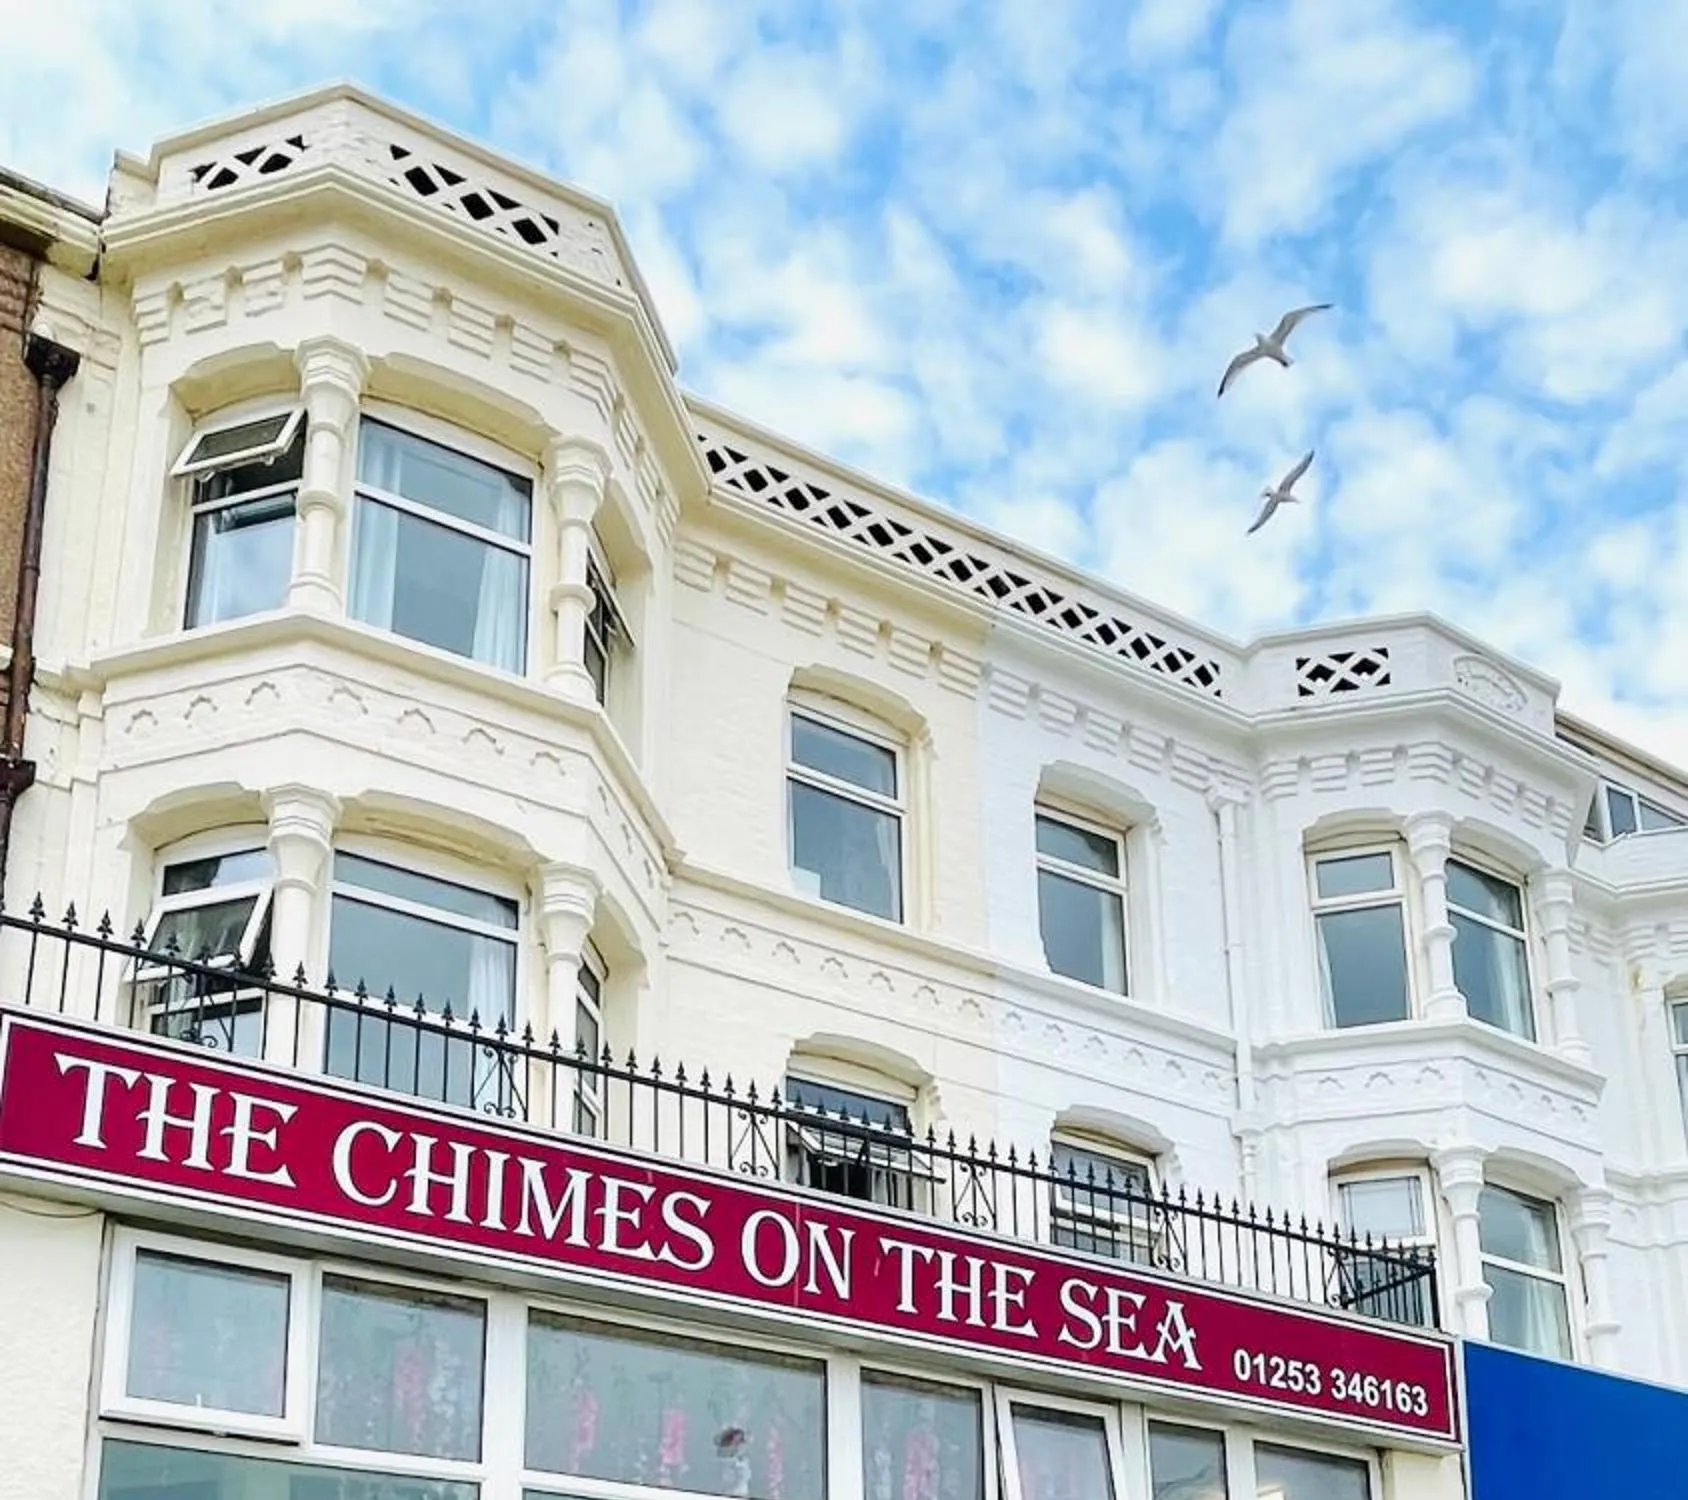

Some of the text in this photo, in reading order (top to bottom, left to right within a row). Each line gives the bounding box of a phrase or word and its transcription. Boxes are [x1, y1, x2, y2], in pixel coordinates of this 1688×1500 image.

[54, 1053, 1203, 1371] THE CHIMES ON THE SEA
[1234, 1348, 1430, 1418] 01253 346163
